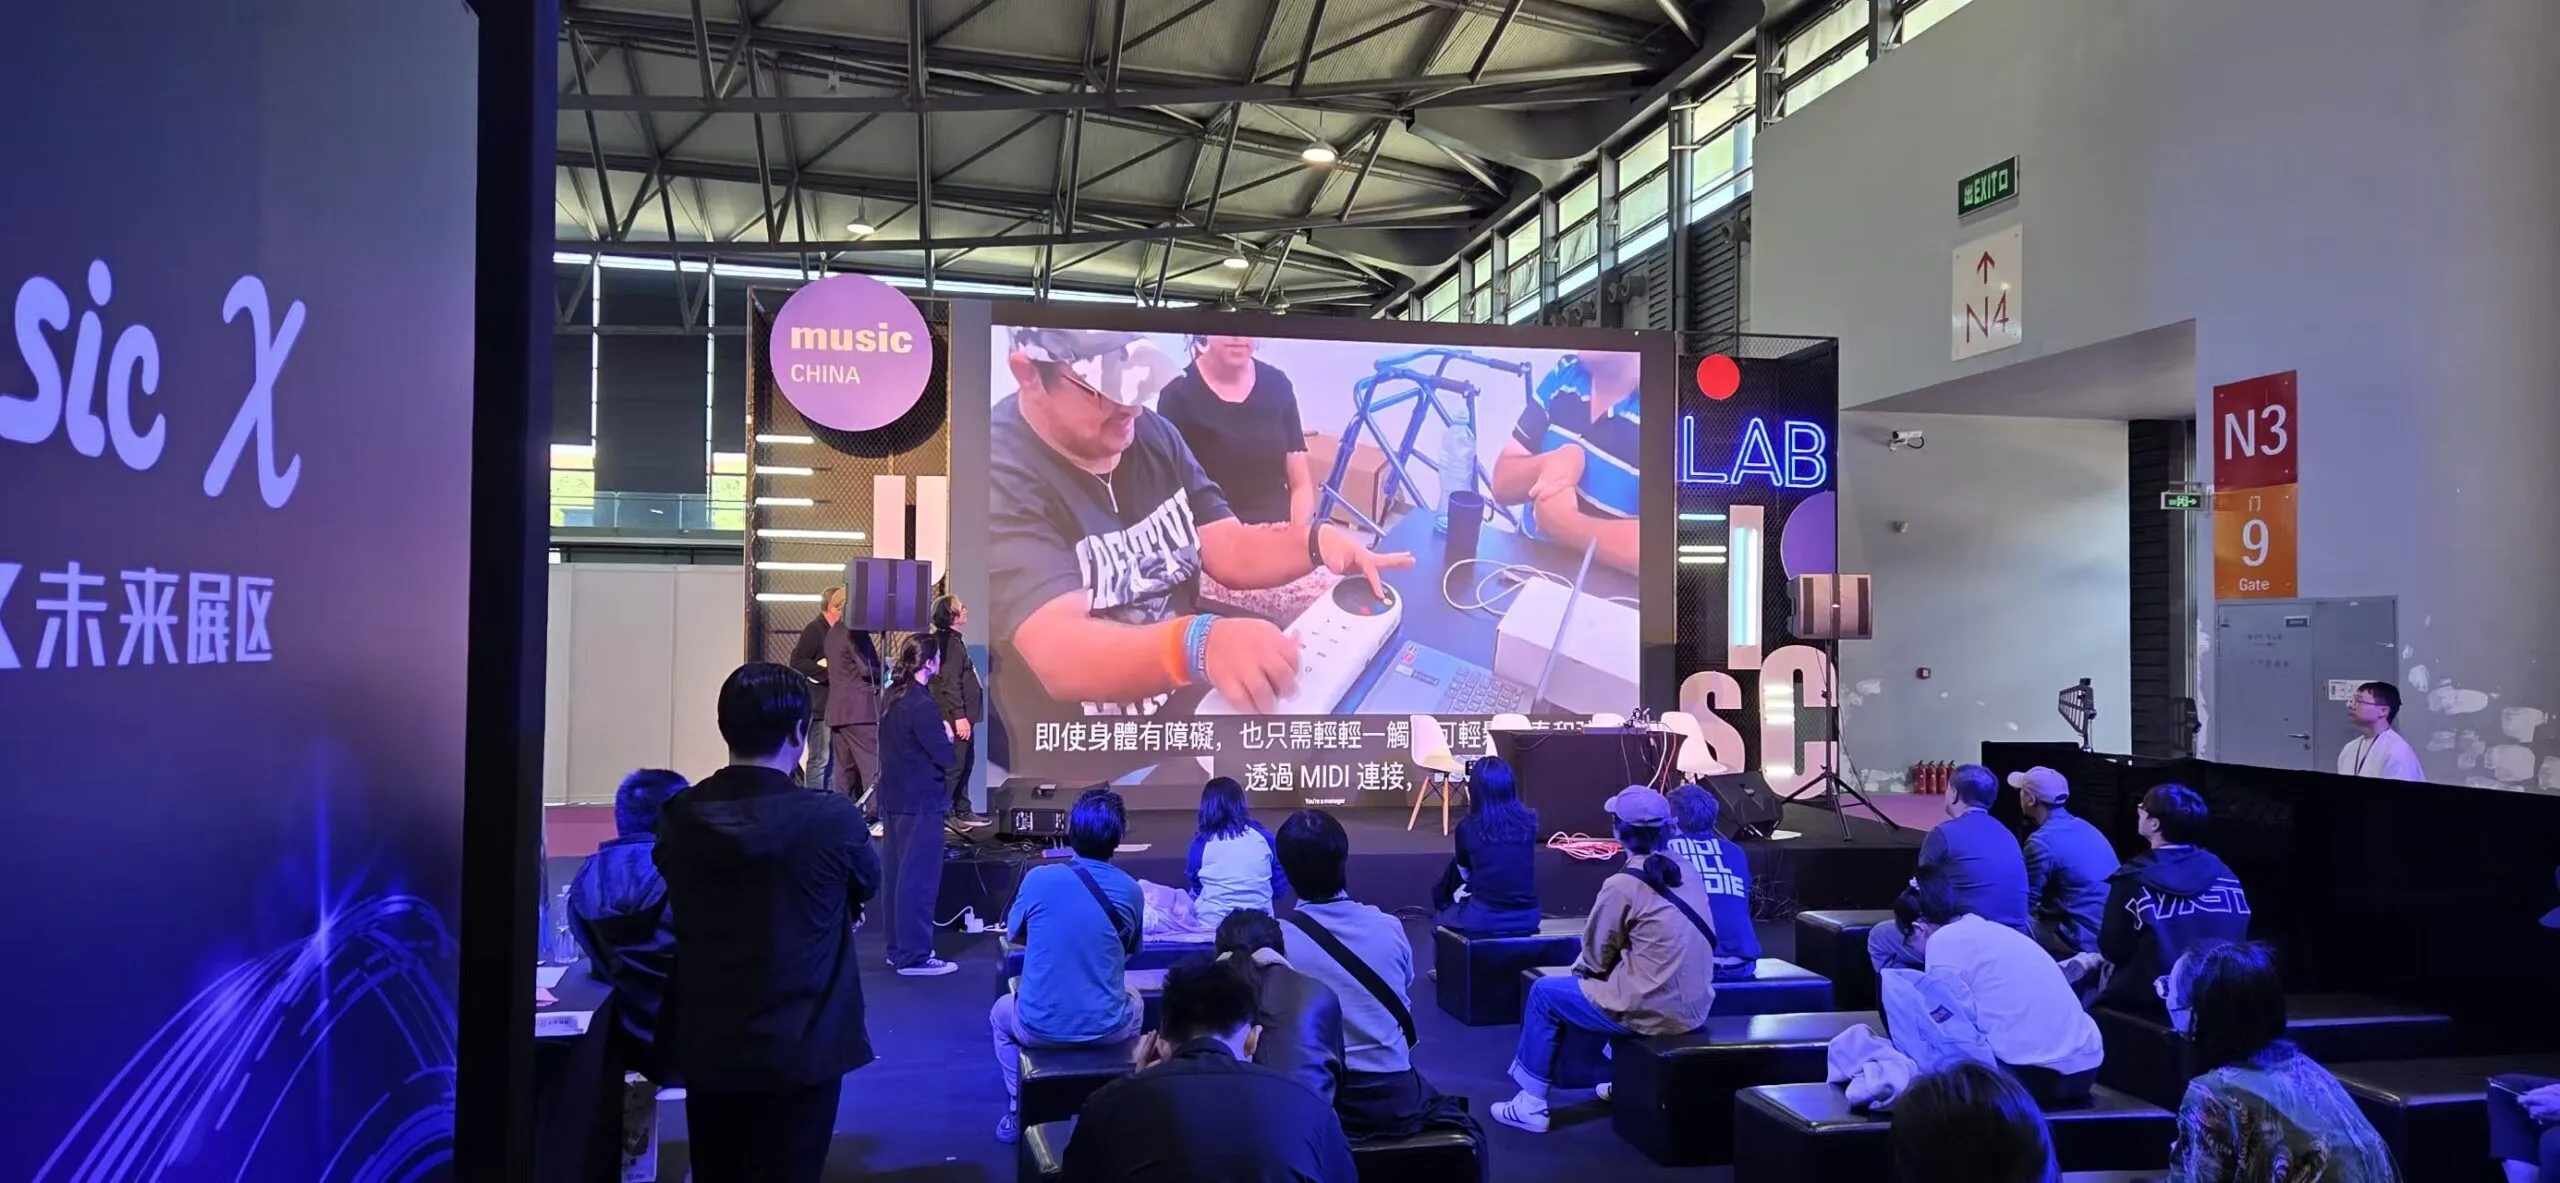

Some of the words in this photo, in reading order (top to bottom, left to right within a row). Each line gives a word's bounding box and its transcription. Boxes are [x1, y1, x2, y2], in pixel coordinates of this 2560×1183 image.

[1965, 288, 2010, 344] N4
[791, 323, 913, 354] music
[791, 363, 860, 385] CHINA
[203, 274, 306, 509] X
[2224, 403, 2289, 461] N3
[1681, 414, 1829, 489] LAB
[2242, 519, 2269, 567] 9
[2239, 577, 2270, 592] Gate
[1245, 763, 1293, 792] 透過
[1301, 763, 1350, 788] MIDI
[1667, 838, 1723, 855] MIDI
[1682, 854, 1732, 874] ILL
